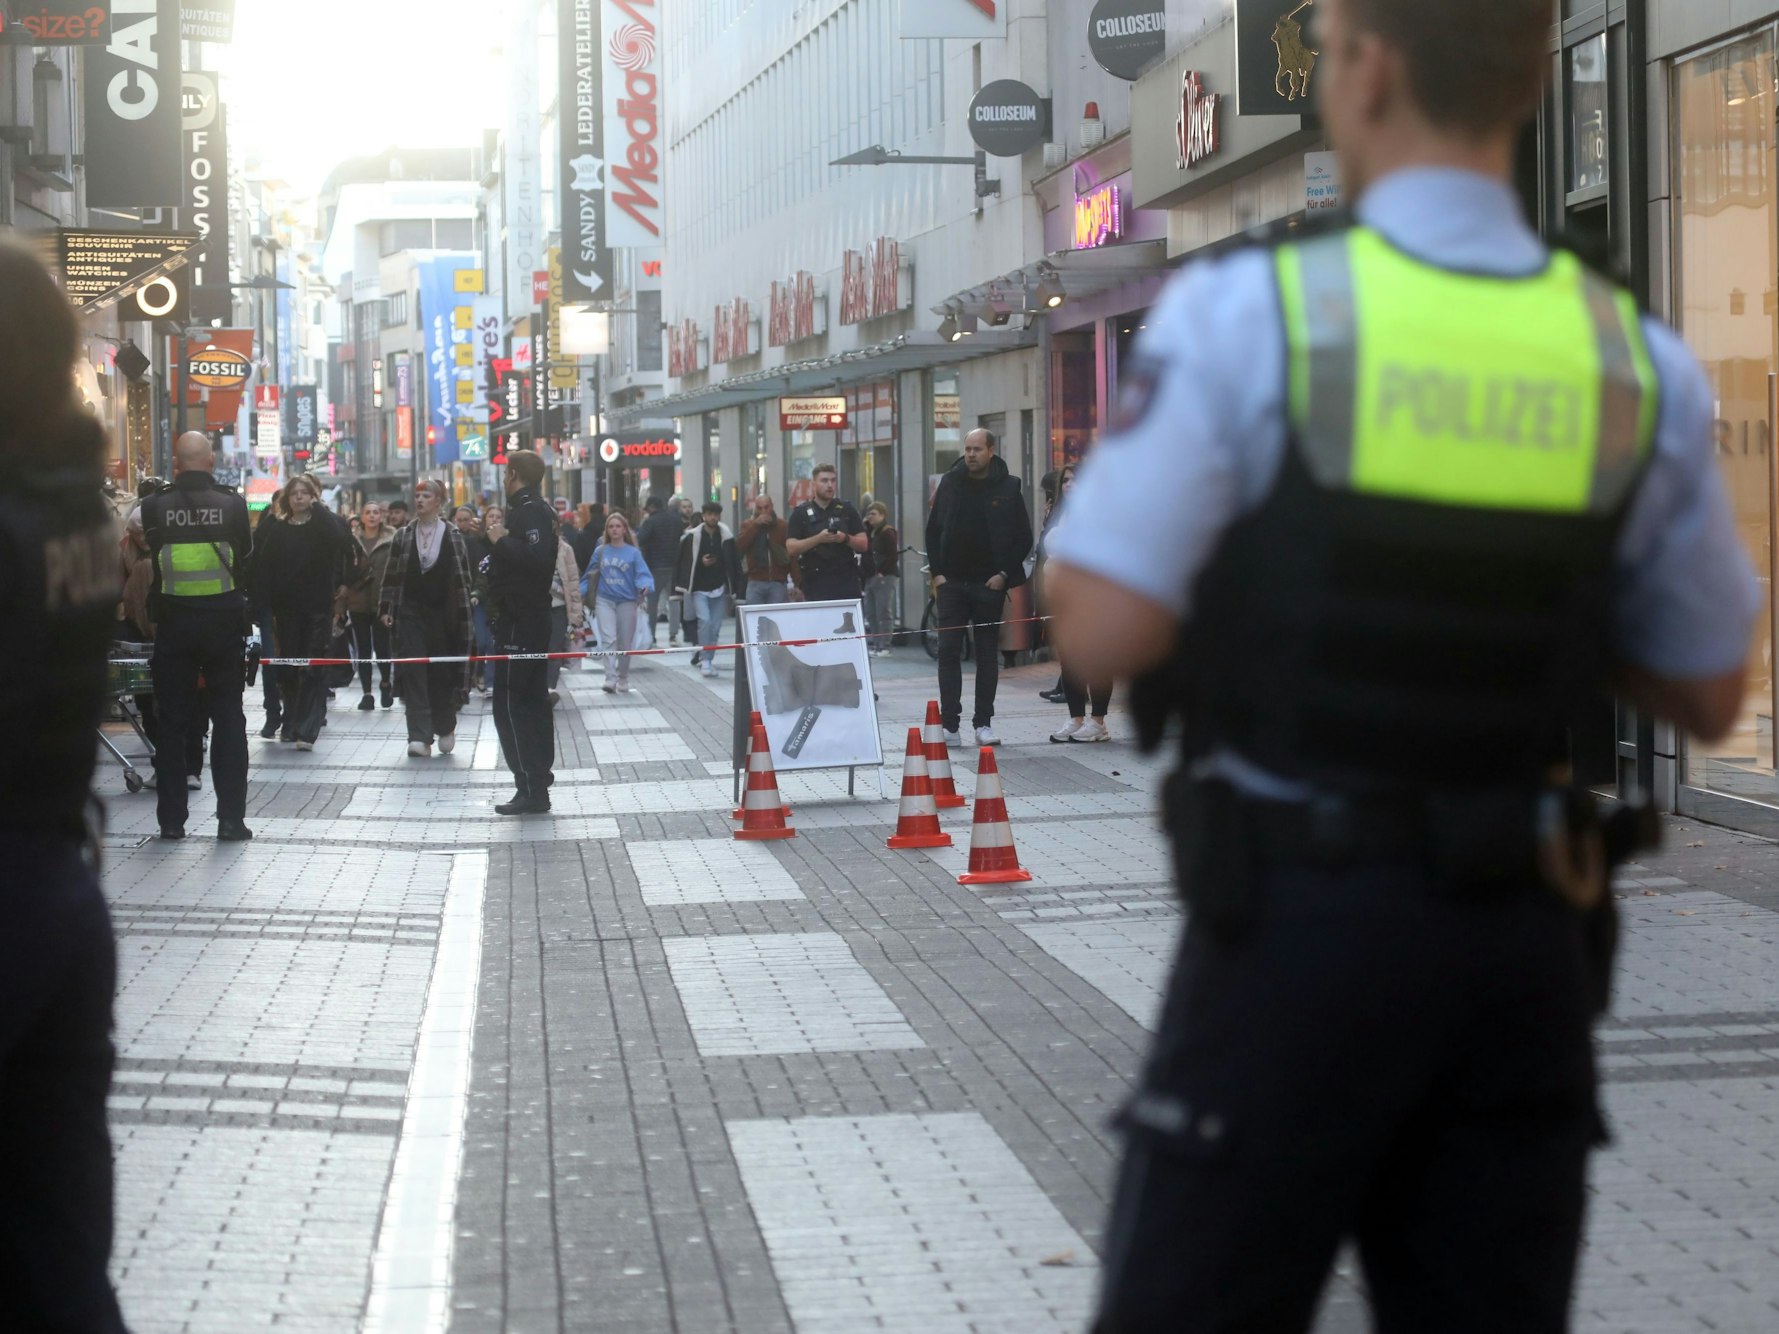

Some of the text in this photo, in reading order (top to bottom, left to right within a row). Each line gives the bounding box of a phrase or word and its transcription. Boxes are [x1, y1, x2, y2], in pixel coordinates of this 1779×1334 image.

[23, 6, 106, 38] size?
[975, 105, 1036, 121] COLLOSEUM
[1306, 186, 1324, 197] Free
[1307, 197, 1337, 209] für alle!
[579, 192, 597, 263] SANDY
[66, 237, 191, 245] GESCHENKARTIKEL
[66, 250, 162, 259] ANTIQUITÄTEN
[66, 279, 120, 287] MÜNZEN
[189, 361, 246, 378] FOSSIL
[1379, 362, 1579, 455] POLIZEI
[166, 508, 223, 527] POLIZEI
